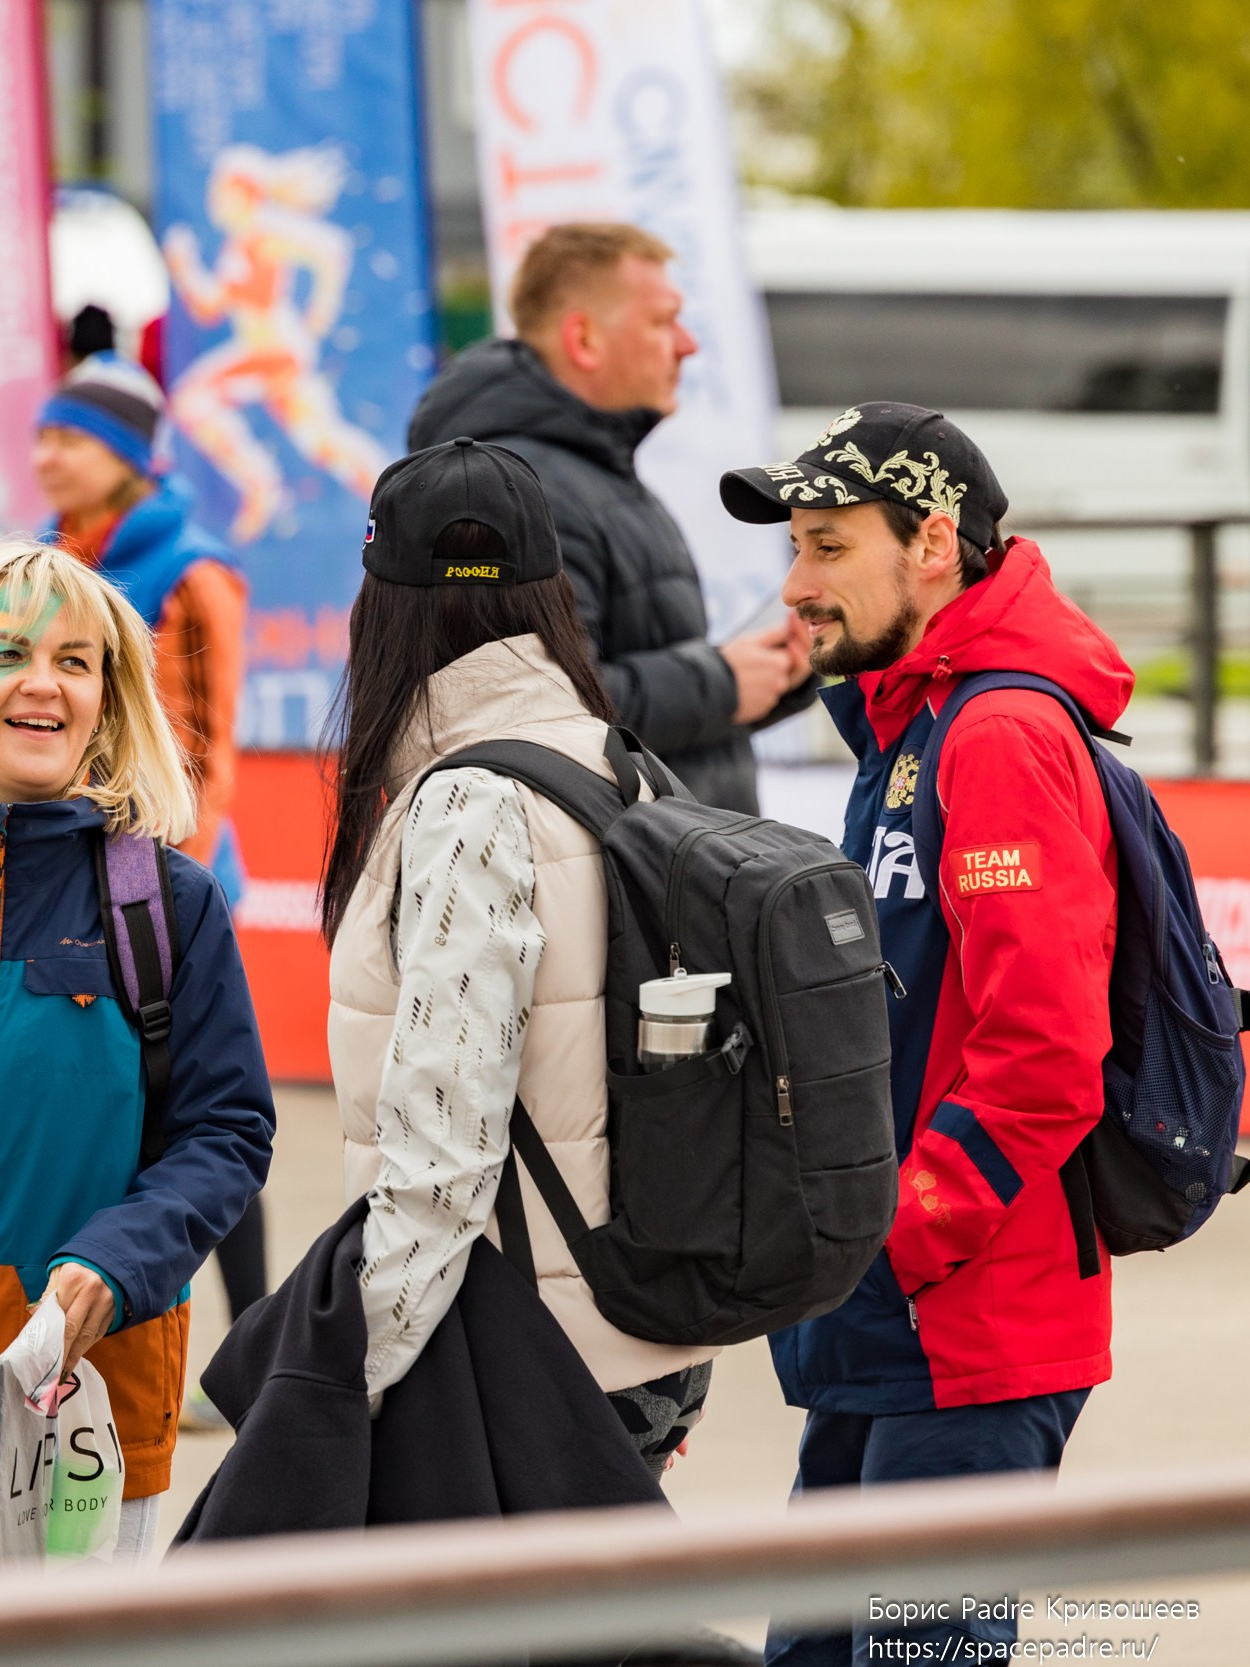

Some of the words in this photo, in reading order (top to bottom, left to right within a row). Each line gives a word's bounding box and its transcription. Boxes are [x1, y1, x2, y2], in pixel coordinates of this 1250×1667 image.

[963, 849, 1021, 870] TEAM
[958, 868, 1033, 893] RUSSIA
[64, 1496, 108, 1512] BODY
